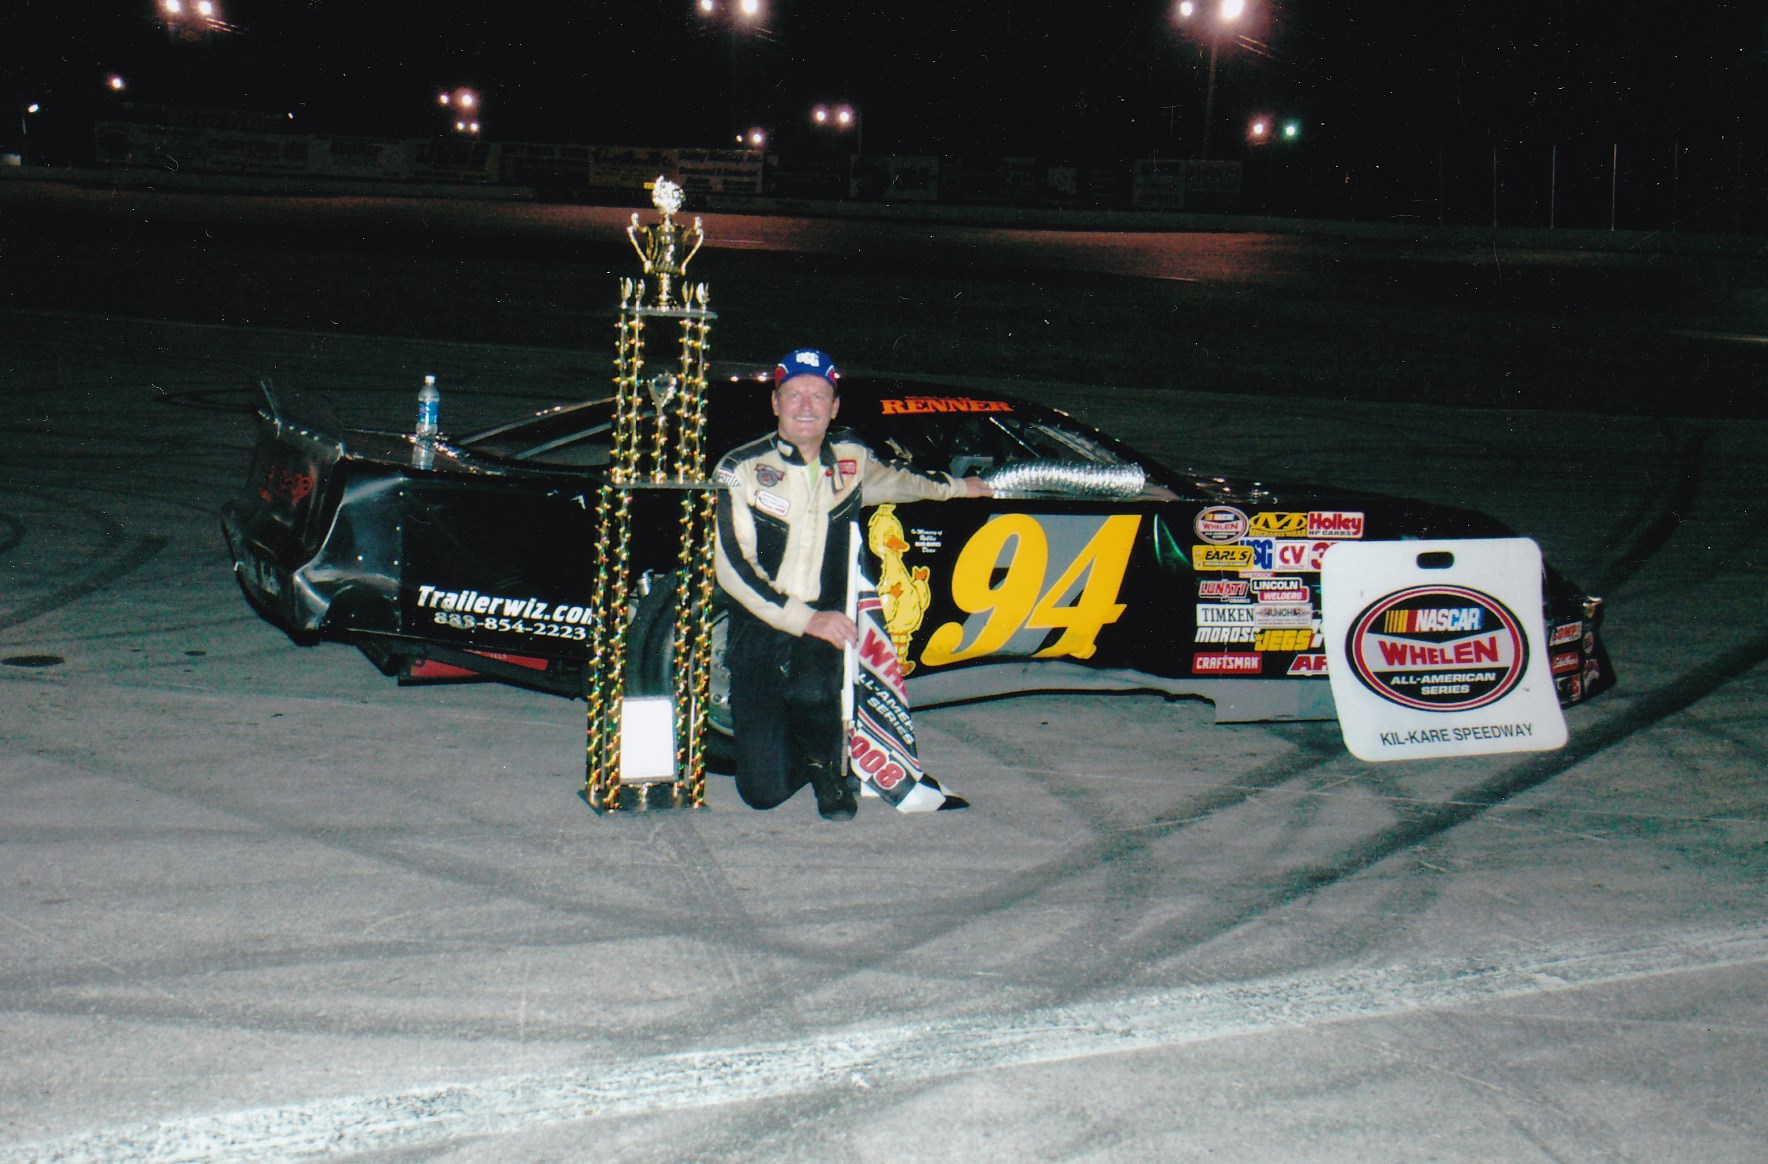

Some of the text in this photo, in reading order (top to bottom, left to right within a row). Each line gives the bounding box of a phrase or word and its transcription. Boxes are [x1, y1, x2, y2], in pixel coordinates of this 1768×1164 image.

[881, 396, 1013, 415] RENNER
[1203, 522, 1238, 530] WHELEN
[1308, 513, 1362, 535] Holley
[1205, 550, 1249, 560] EARL'S
[1279, 545, 1305, 564] CV
[921, 513, 1142, 666] 94
[1253, 580, 1298, 591] LINCOLN
[1263, 592, 1302, 601] WELDERS
[1202, 608, 1254, 622] TIMKEN
[1415, 607, 1481, 631] NASCAR
[433, 611, 587, 641] 888-854-2223
[1254, 629, 1313, 651] JEGS
[1378, 636, 1499, 667] WHELEN
[1196, 656, 1261, 669] CRAFTSMAN
[1390, 672, 1496, 686] ALL-AMERICAN
[1420, 685, 1470, 695] SERIES
[866, 696, 915, 745] SERIES
[1380, 723, 1533, 746] KIL-KARE SPEEDWAY
[848, 728, 905, 788] 008
